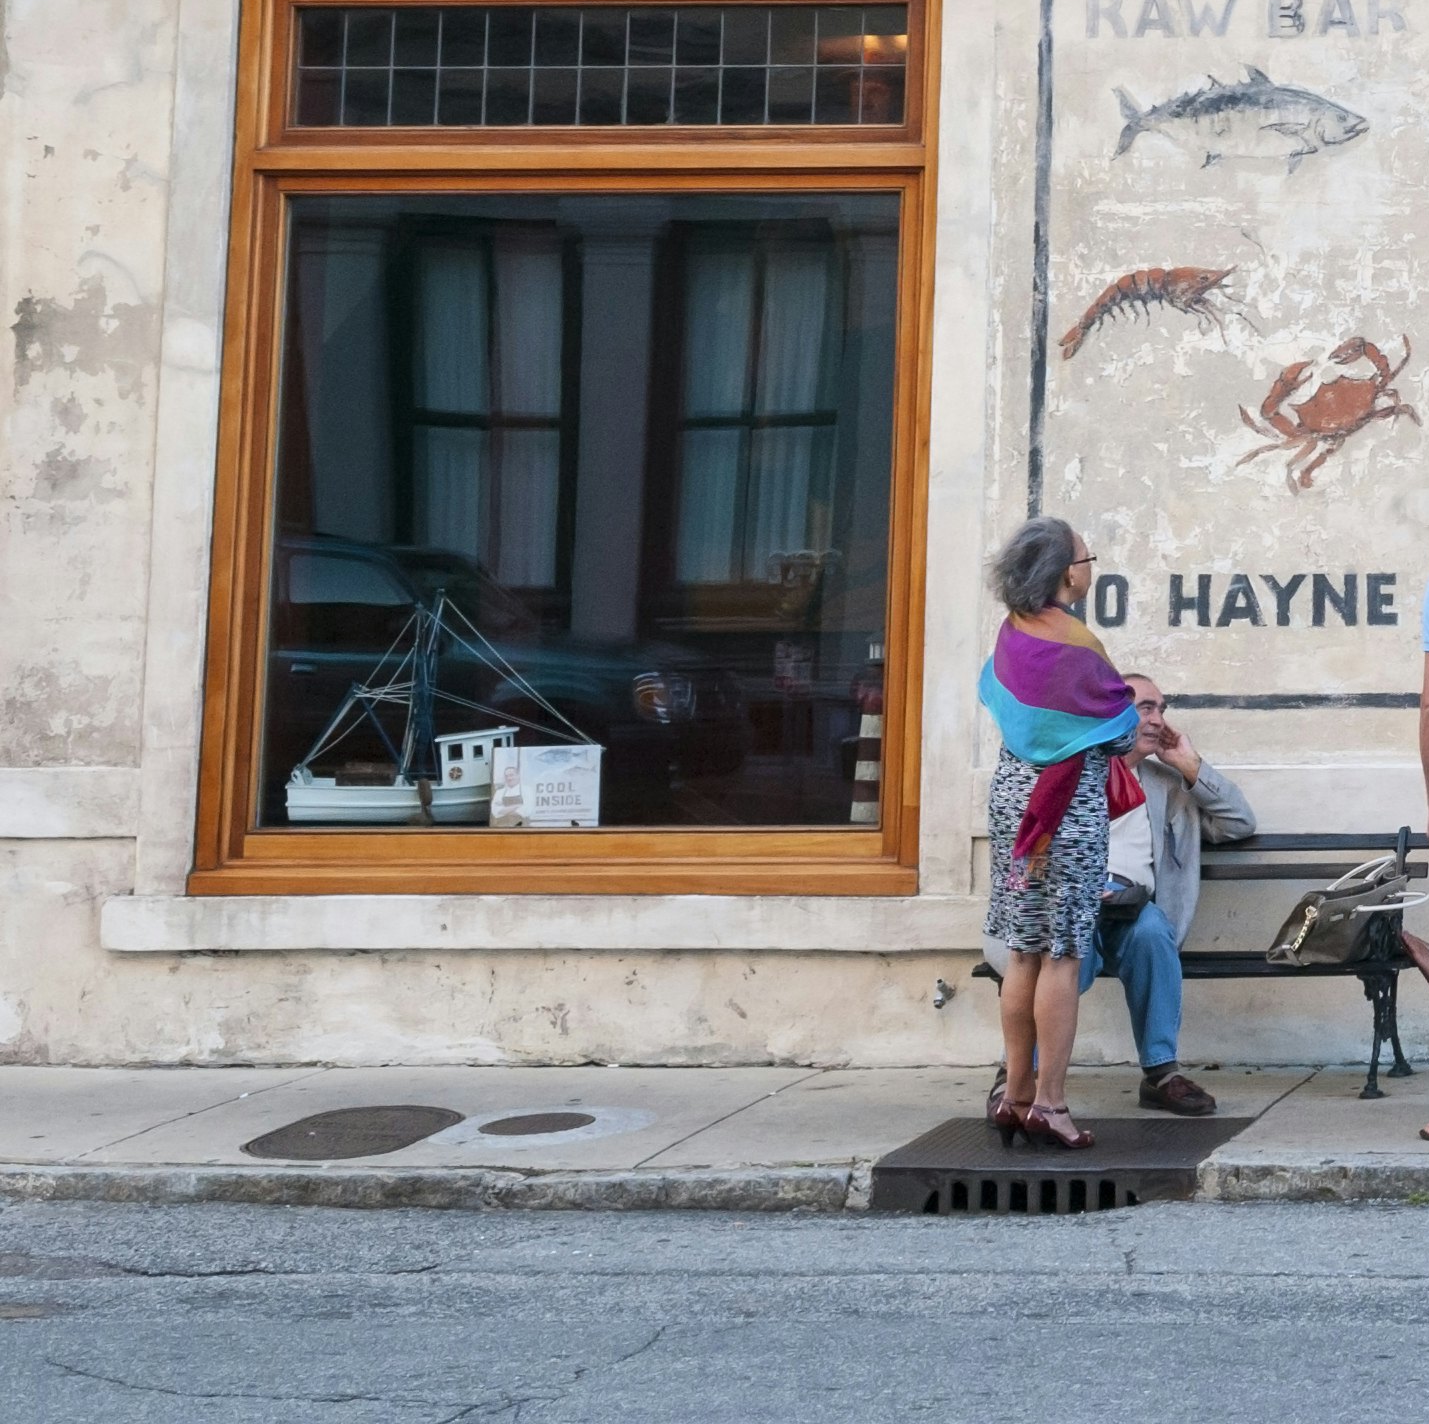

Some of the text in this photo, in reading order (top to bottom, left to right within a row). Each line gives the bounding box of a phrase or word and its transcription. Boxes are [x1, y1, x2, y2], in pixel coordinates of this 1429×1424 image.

[1168, 572, 1400, 627] HAYNE
[536, 782, 576, 794] COOL
[536, 795, 583, 807] INSIDE
